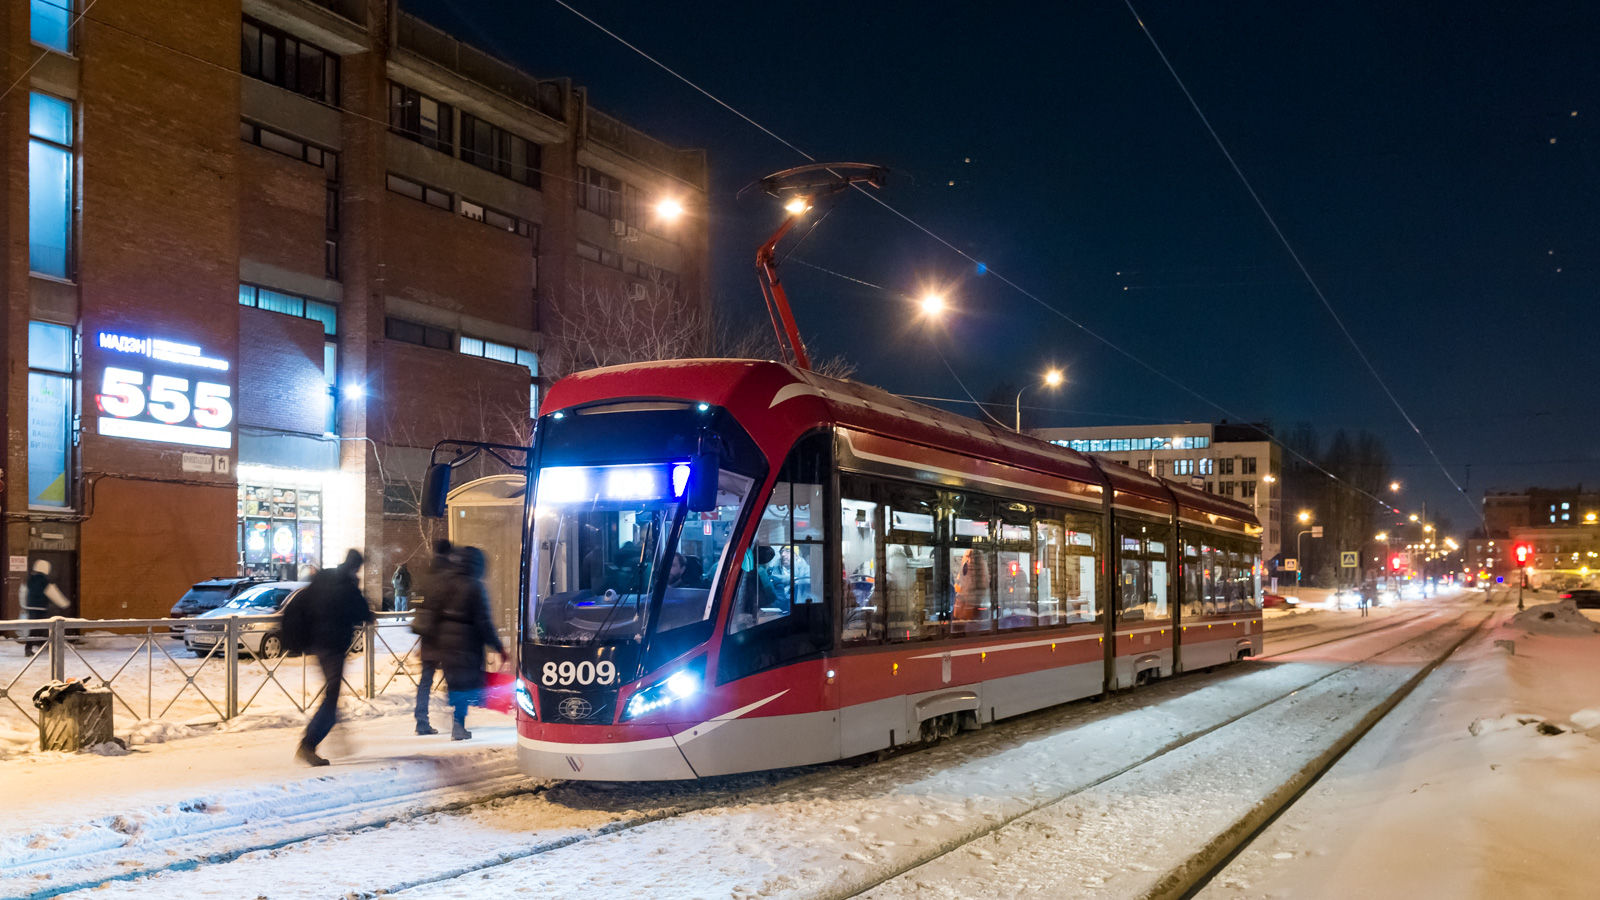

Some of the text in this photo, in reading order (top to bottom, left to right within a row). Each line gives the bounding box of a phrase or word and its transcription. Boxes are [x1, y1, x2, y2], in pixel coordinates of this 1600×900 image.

[100, 332, 146, 354] МАДЭН
[100, 367, 233, 429] 555
[541, 660, 616, 686] 8909
